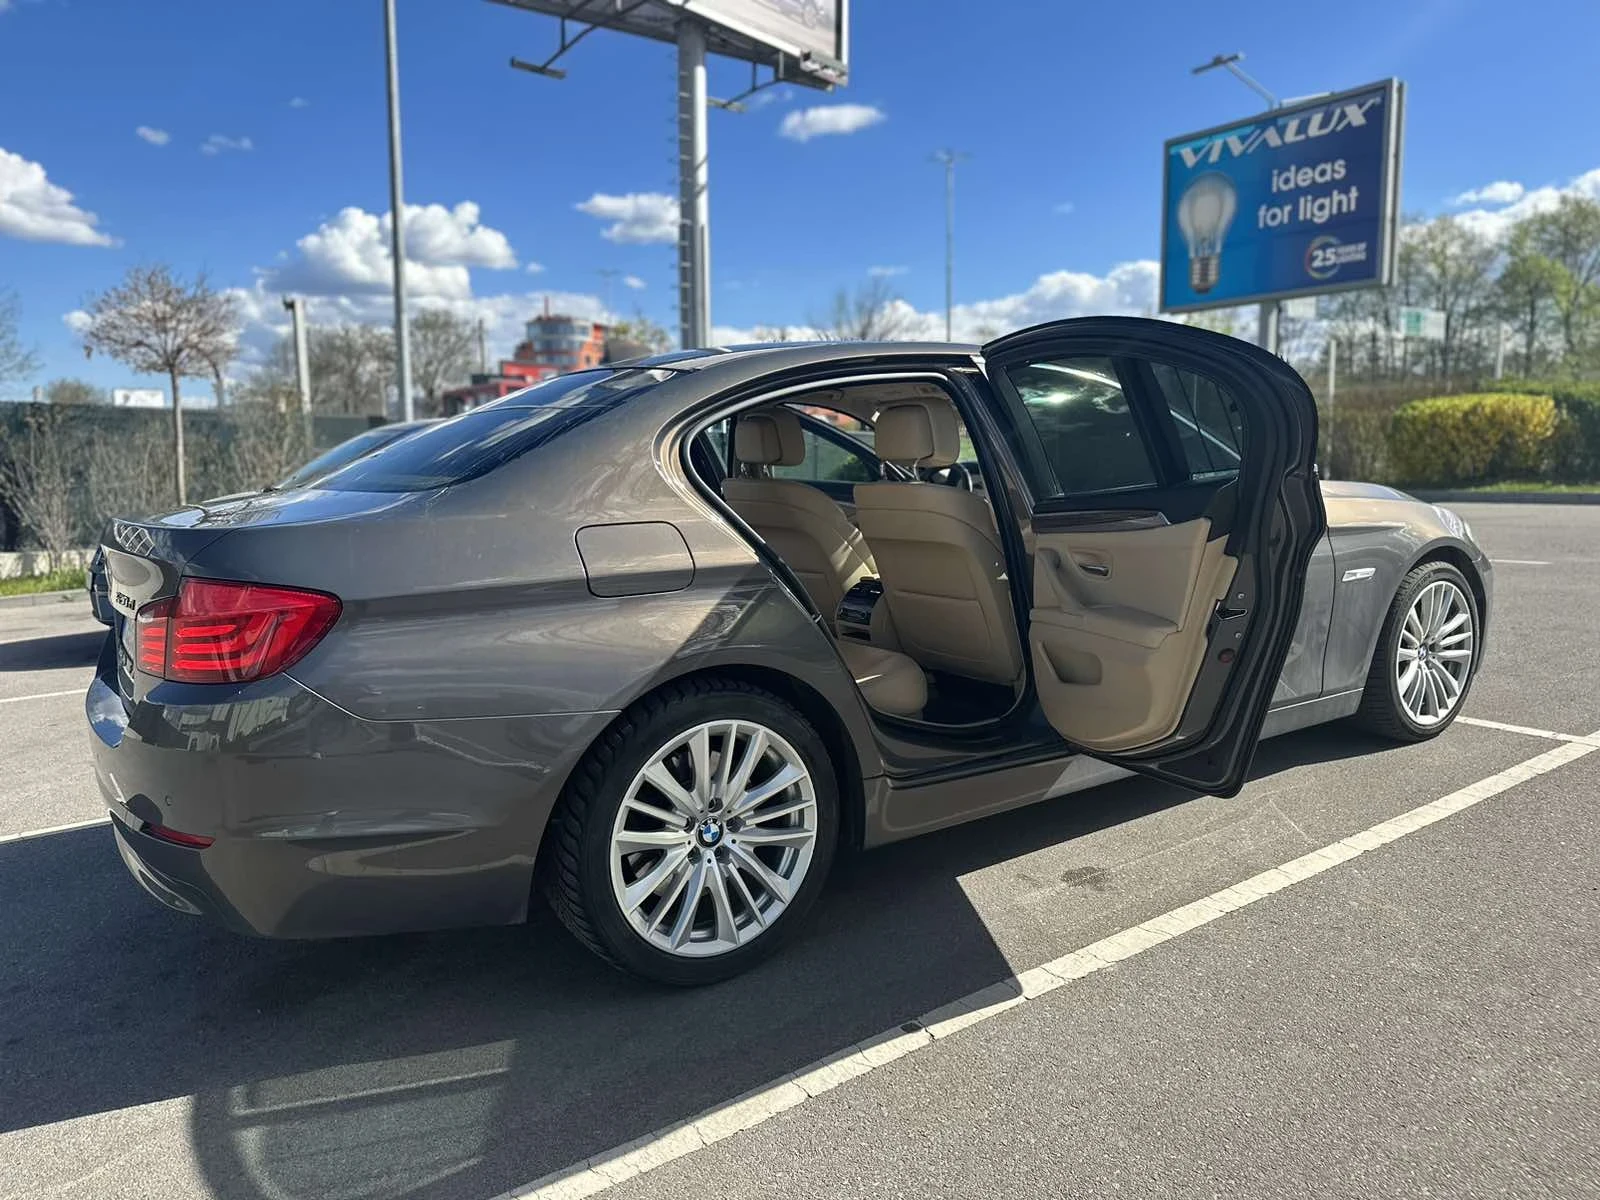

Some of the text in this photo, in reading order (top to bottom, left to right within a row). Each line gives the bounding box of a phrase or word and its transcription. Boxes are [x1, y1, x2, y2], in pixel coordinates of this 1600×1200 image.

[1180, 98, 1376, 168] VIVALUX
[1271, 159, 1347, 193] ideas
[1258, 186, 1359, 230] for light
[1311, 248, 1336, 268] 25
